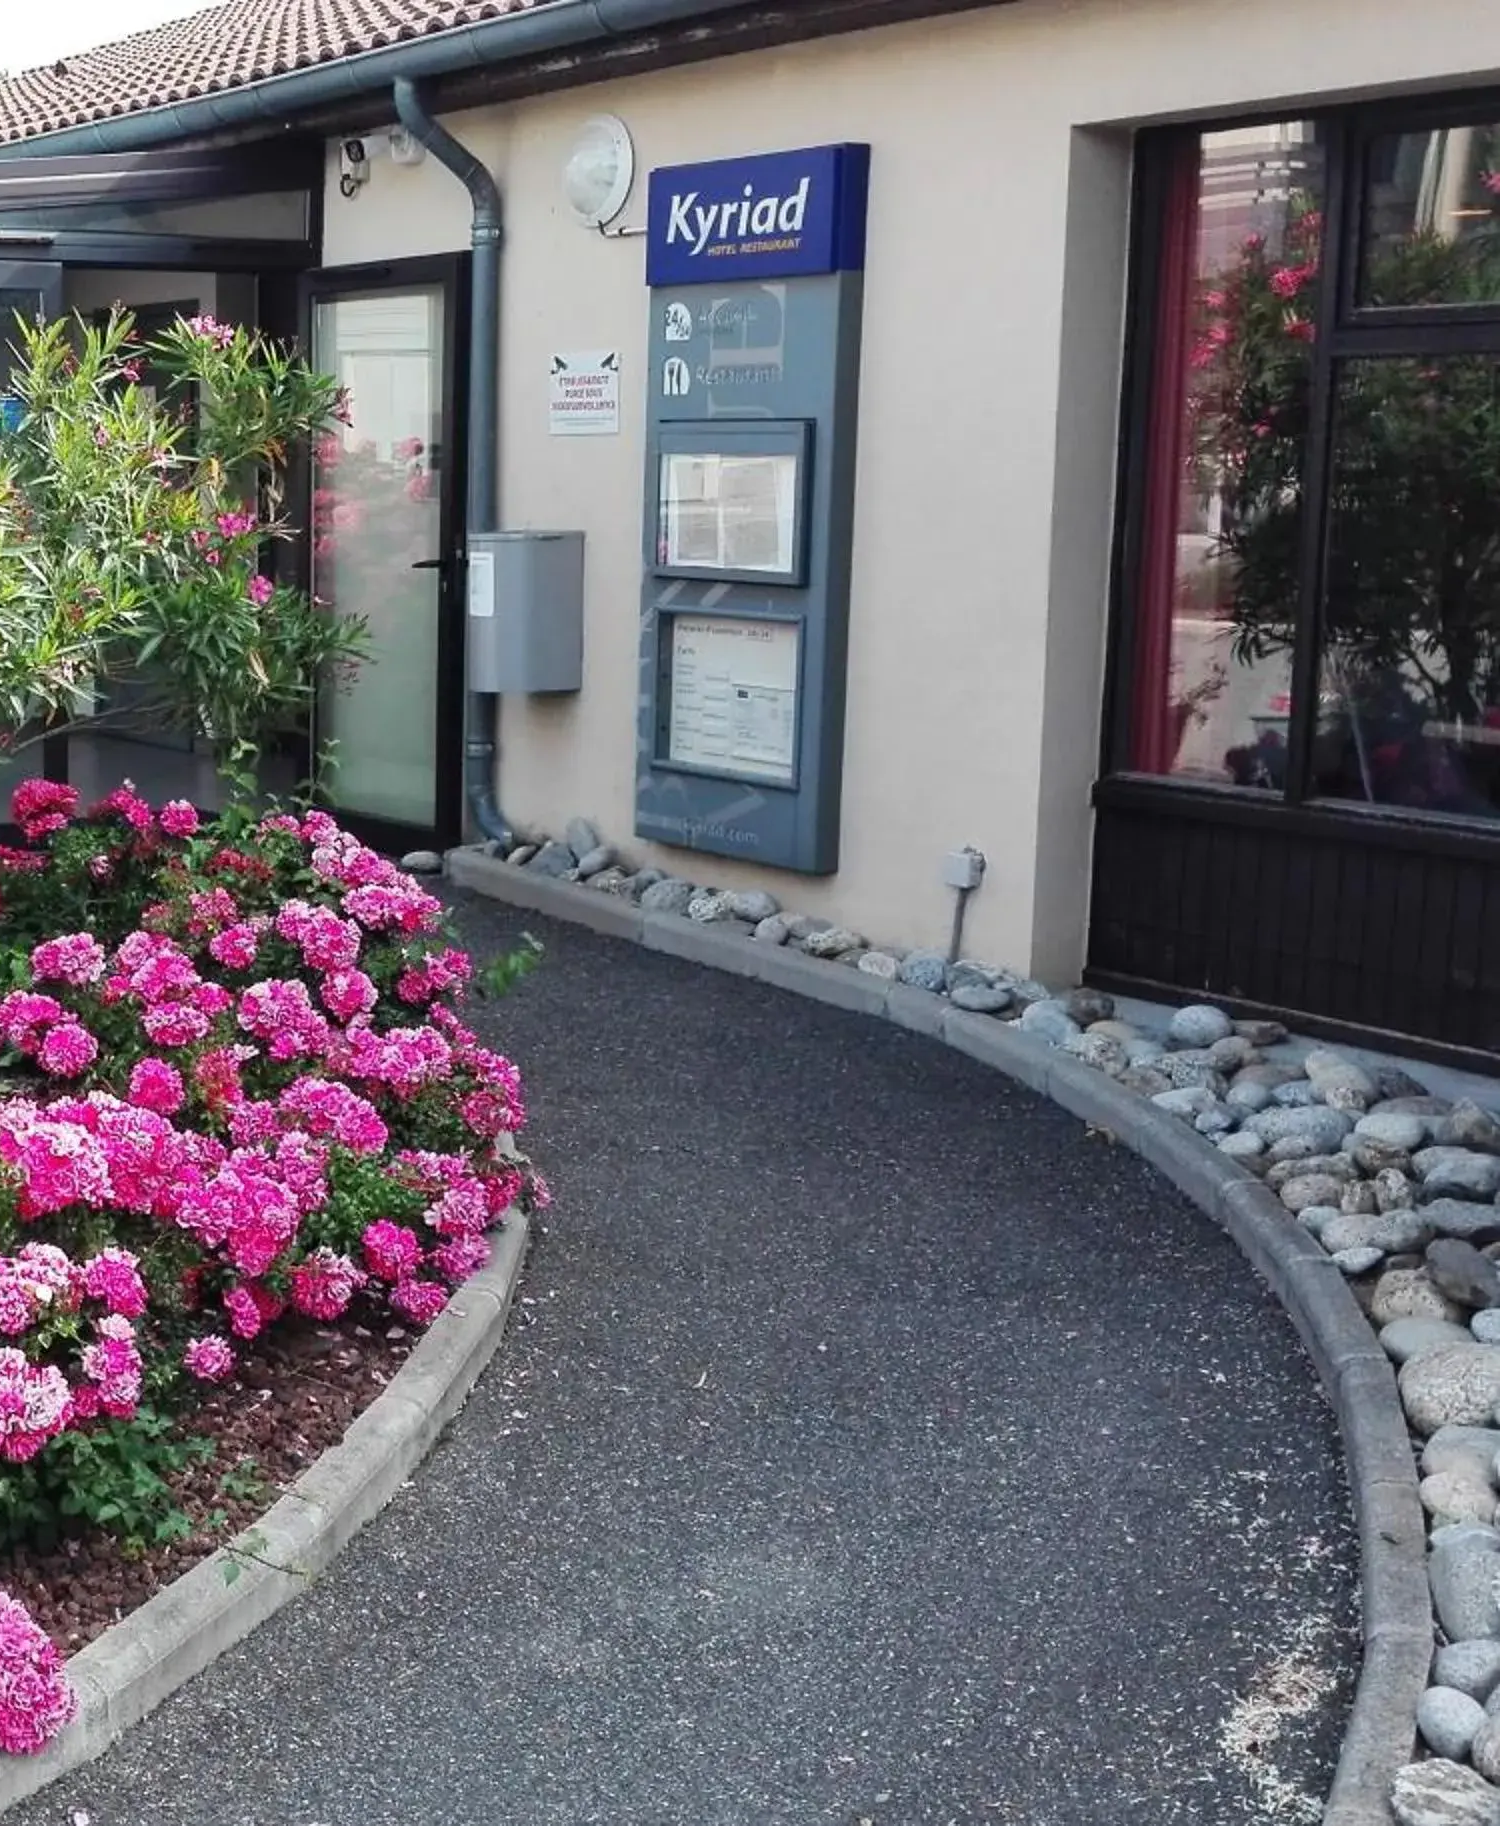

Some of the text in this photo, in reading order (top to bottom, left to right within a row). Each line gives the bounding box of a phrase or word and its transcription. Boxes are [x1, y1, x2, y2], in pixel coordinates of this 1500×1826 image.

[666, 175, 811, 256] Kyriad
[707, 237, 803, 256] HOTEL RESTAURANT
